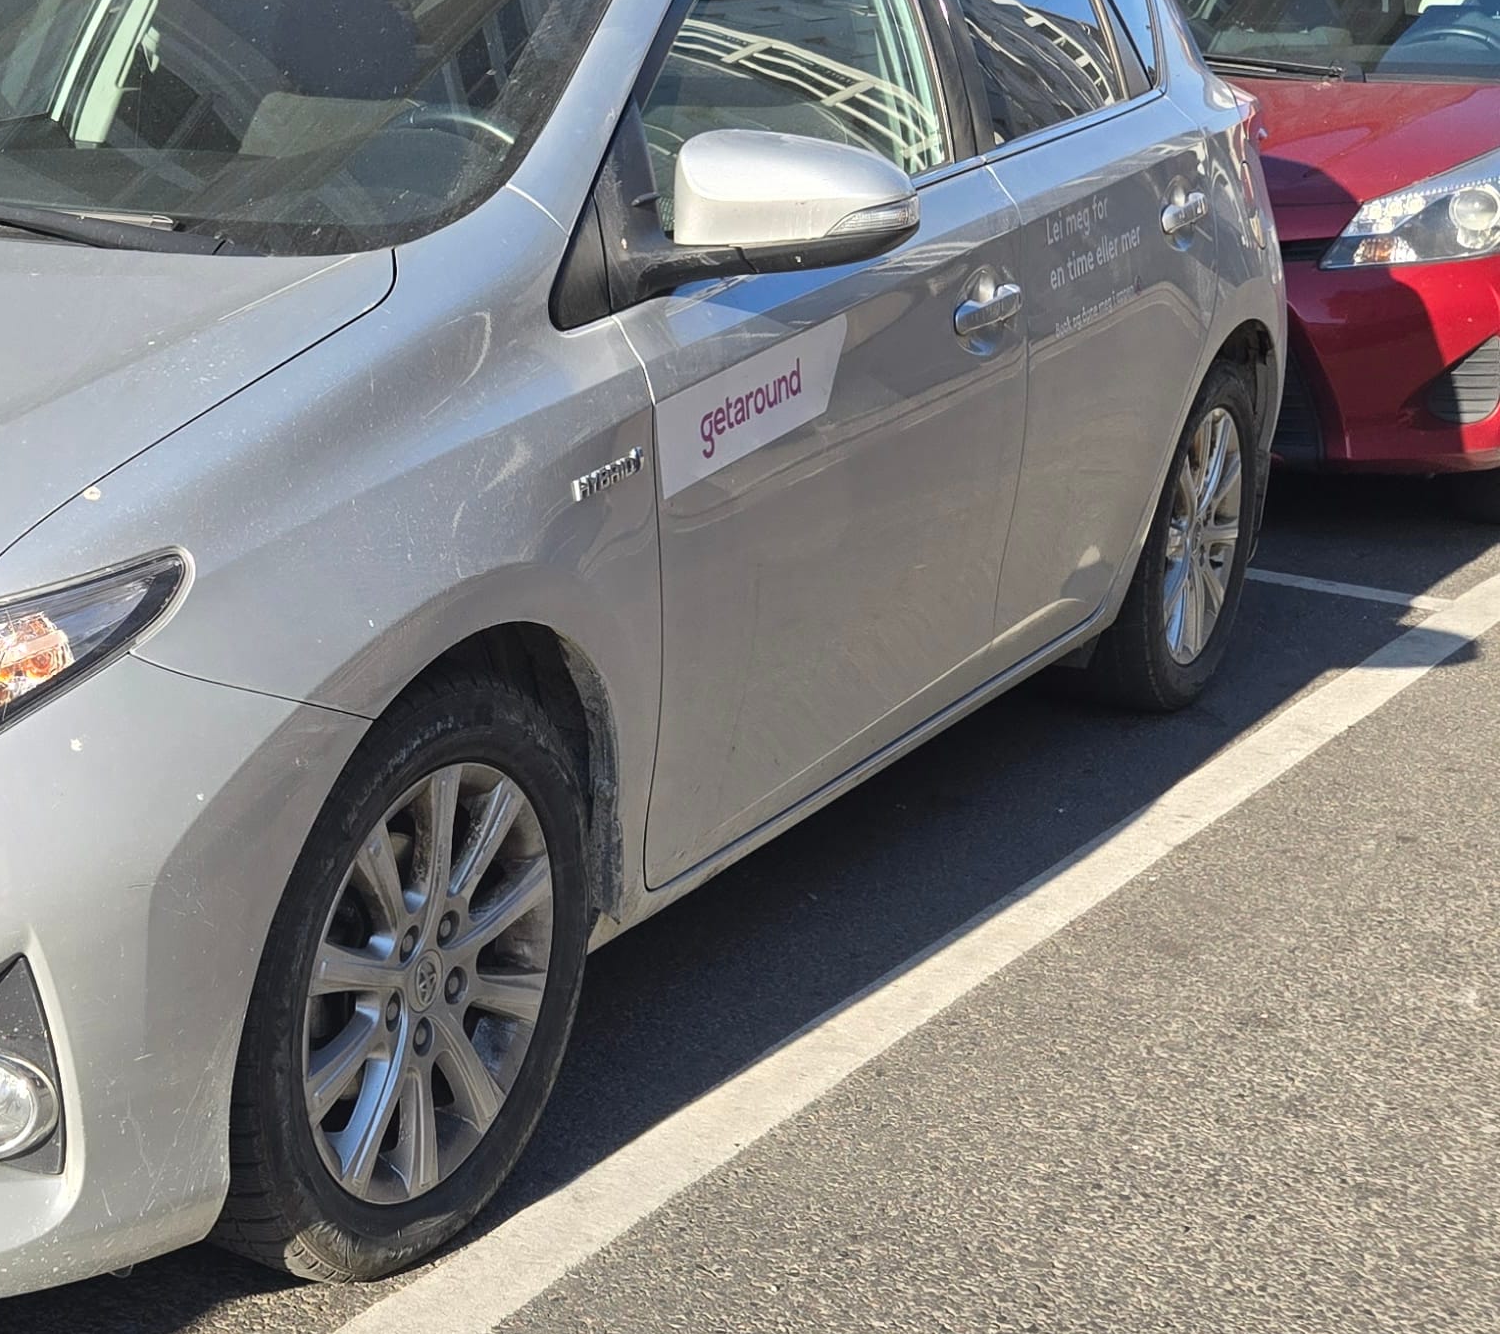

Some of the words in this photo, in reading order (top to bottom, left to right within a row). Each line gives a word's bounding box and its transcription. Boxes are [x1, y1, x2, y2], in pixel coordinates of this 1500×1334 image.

[1046, 211, 1063, 245] Lei
[1066, 207, 1090, 236] meg
[1092, 194, 1108, 223] for
[1050, 266, 1065, 290] en
[1067, 250, 1094, 281] time
[1096, 234, 1118, 266] eller
[1121, 225, 1140, 253] mer
[700, 358, 801, 458] getaround
[571, 447, 643, 502] HYBRID
